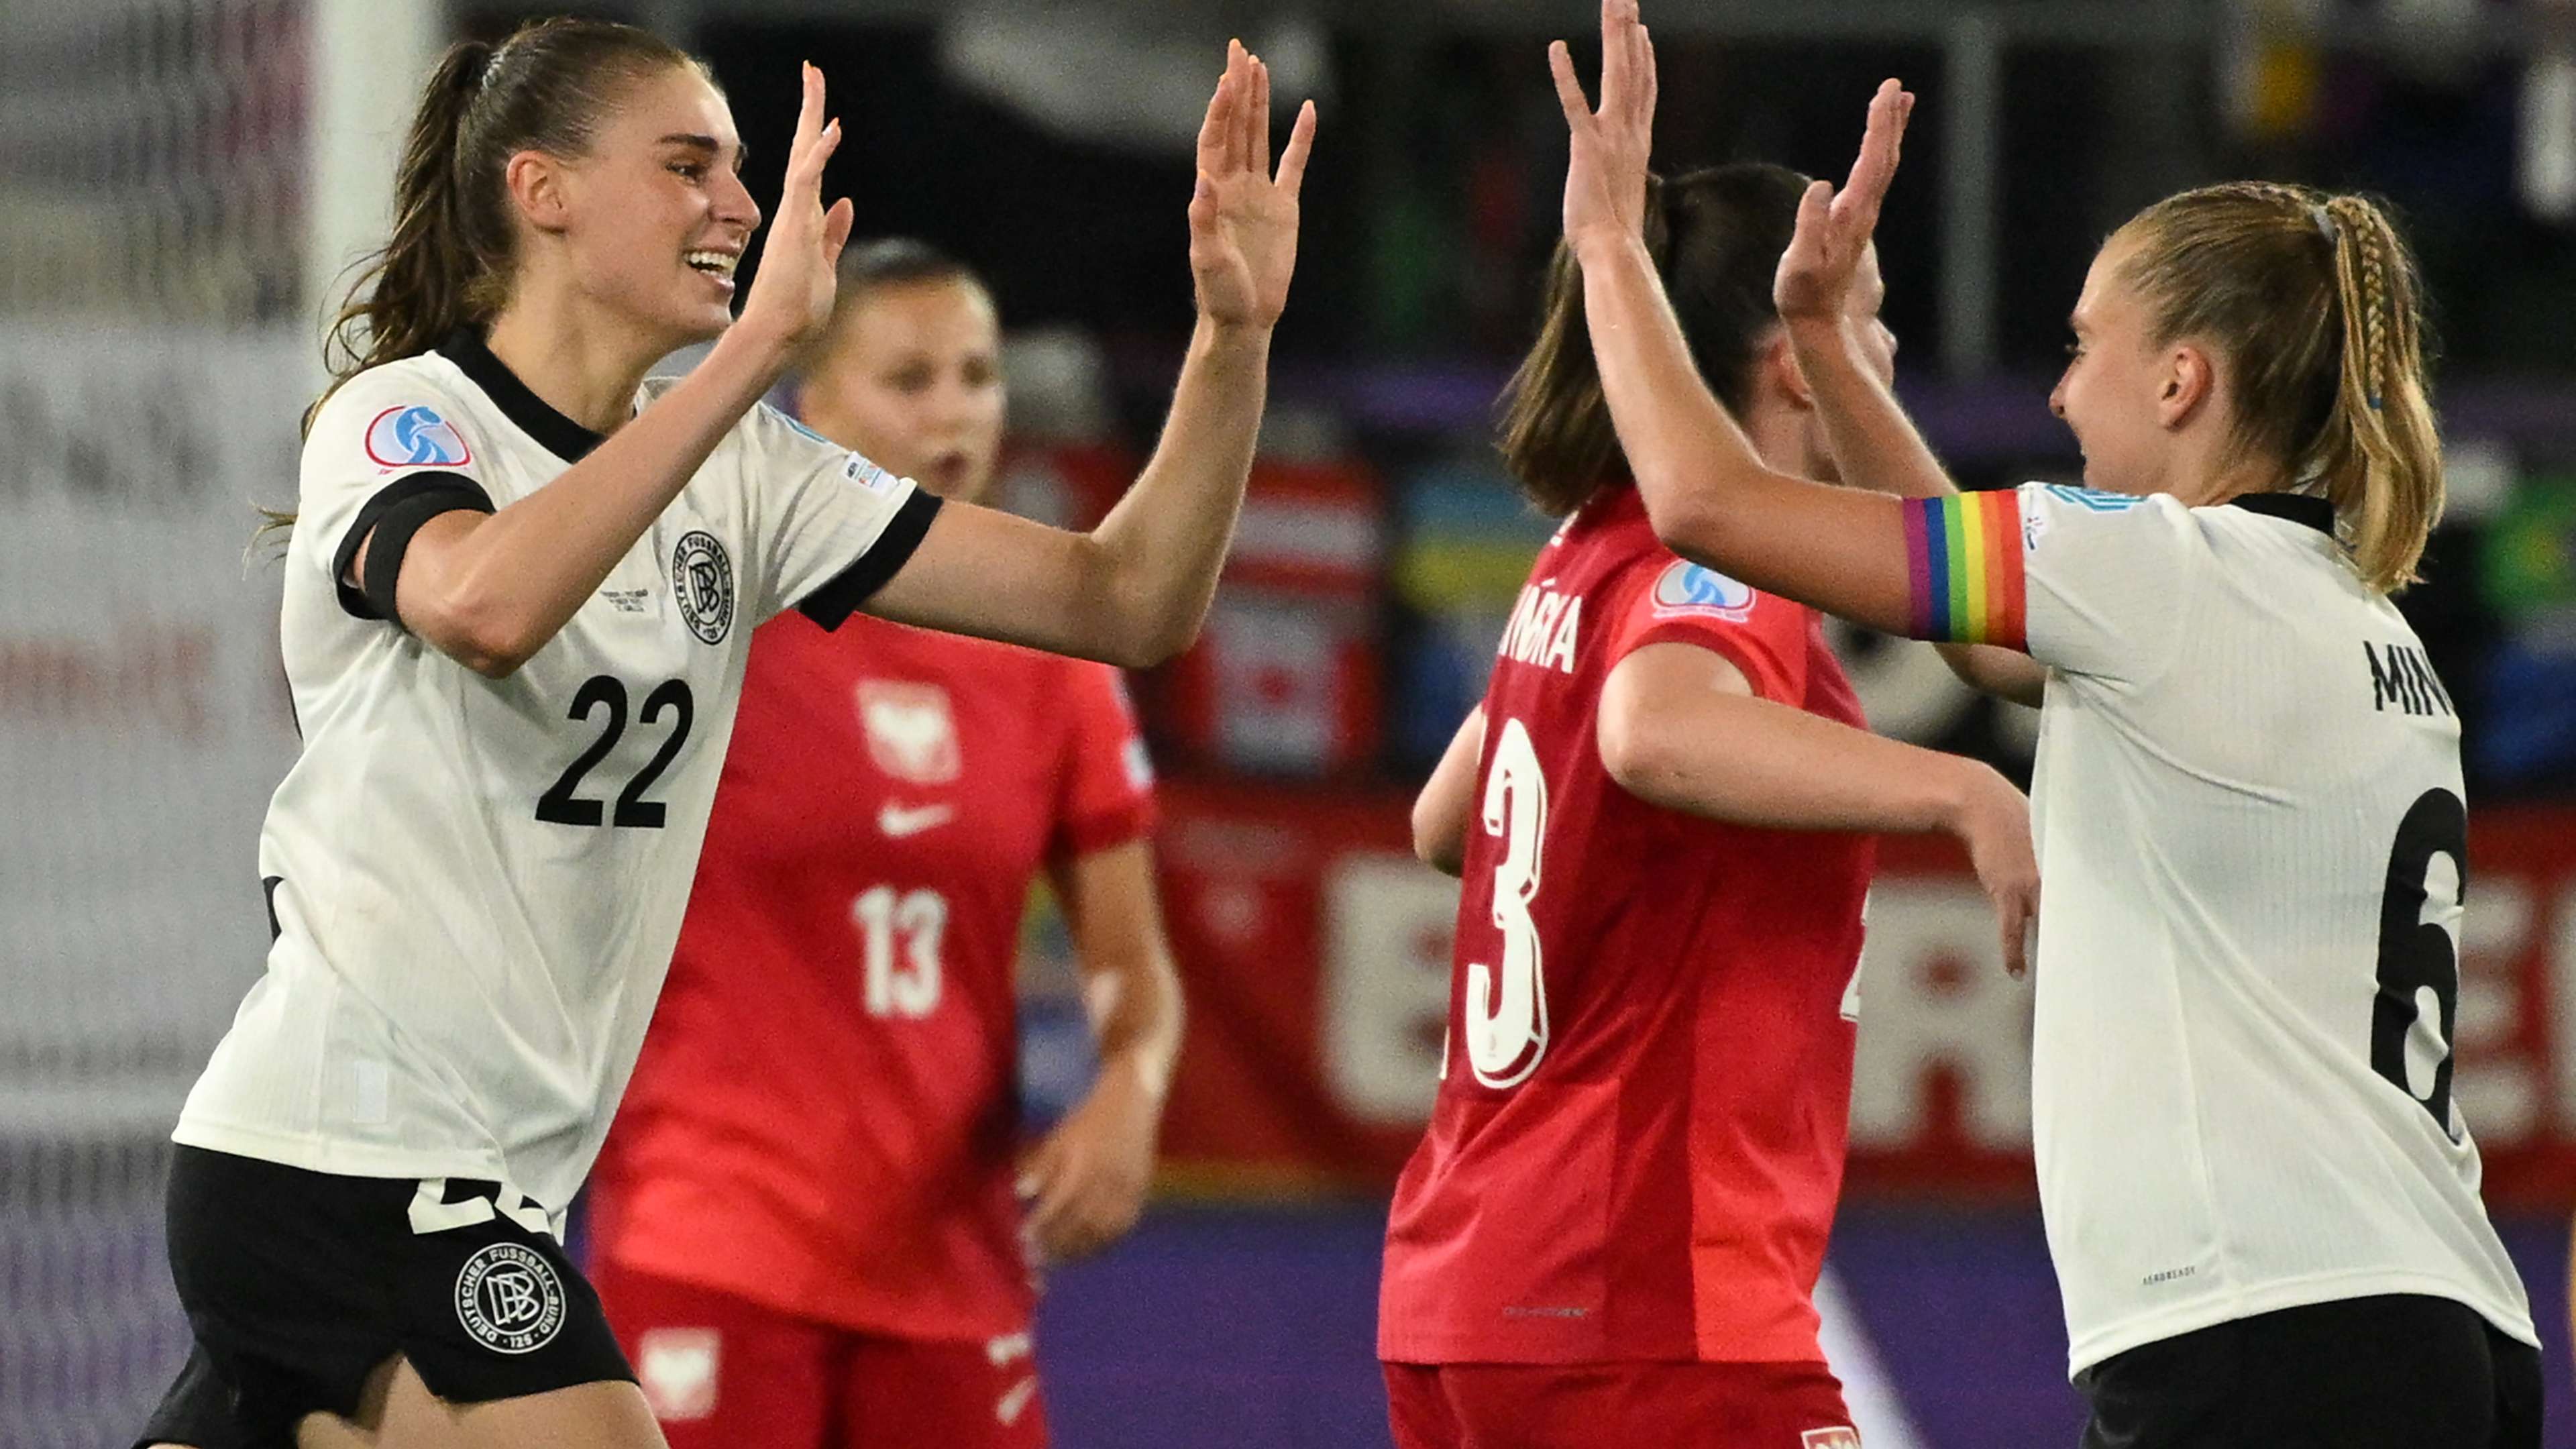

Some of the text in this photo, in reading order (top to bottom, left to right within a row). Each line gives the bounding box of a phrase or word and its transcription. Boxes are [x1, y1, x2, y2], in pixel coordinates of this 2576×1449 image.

[2363, 640, 2454, 716] MIN
[535, 674, 694, 828] 22
[853, 885, 949, 1018] 13
[1440, 717, 1549, 1089] 3
[2370, 787, 2469, 1145] 6
[462, 1247, 559, 1343] DEUTSCHER FUSSBALL-BUND
[509, 1334, 535, 1348] 125
